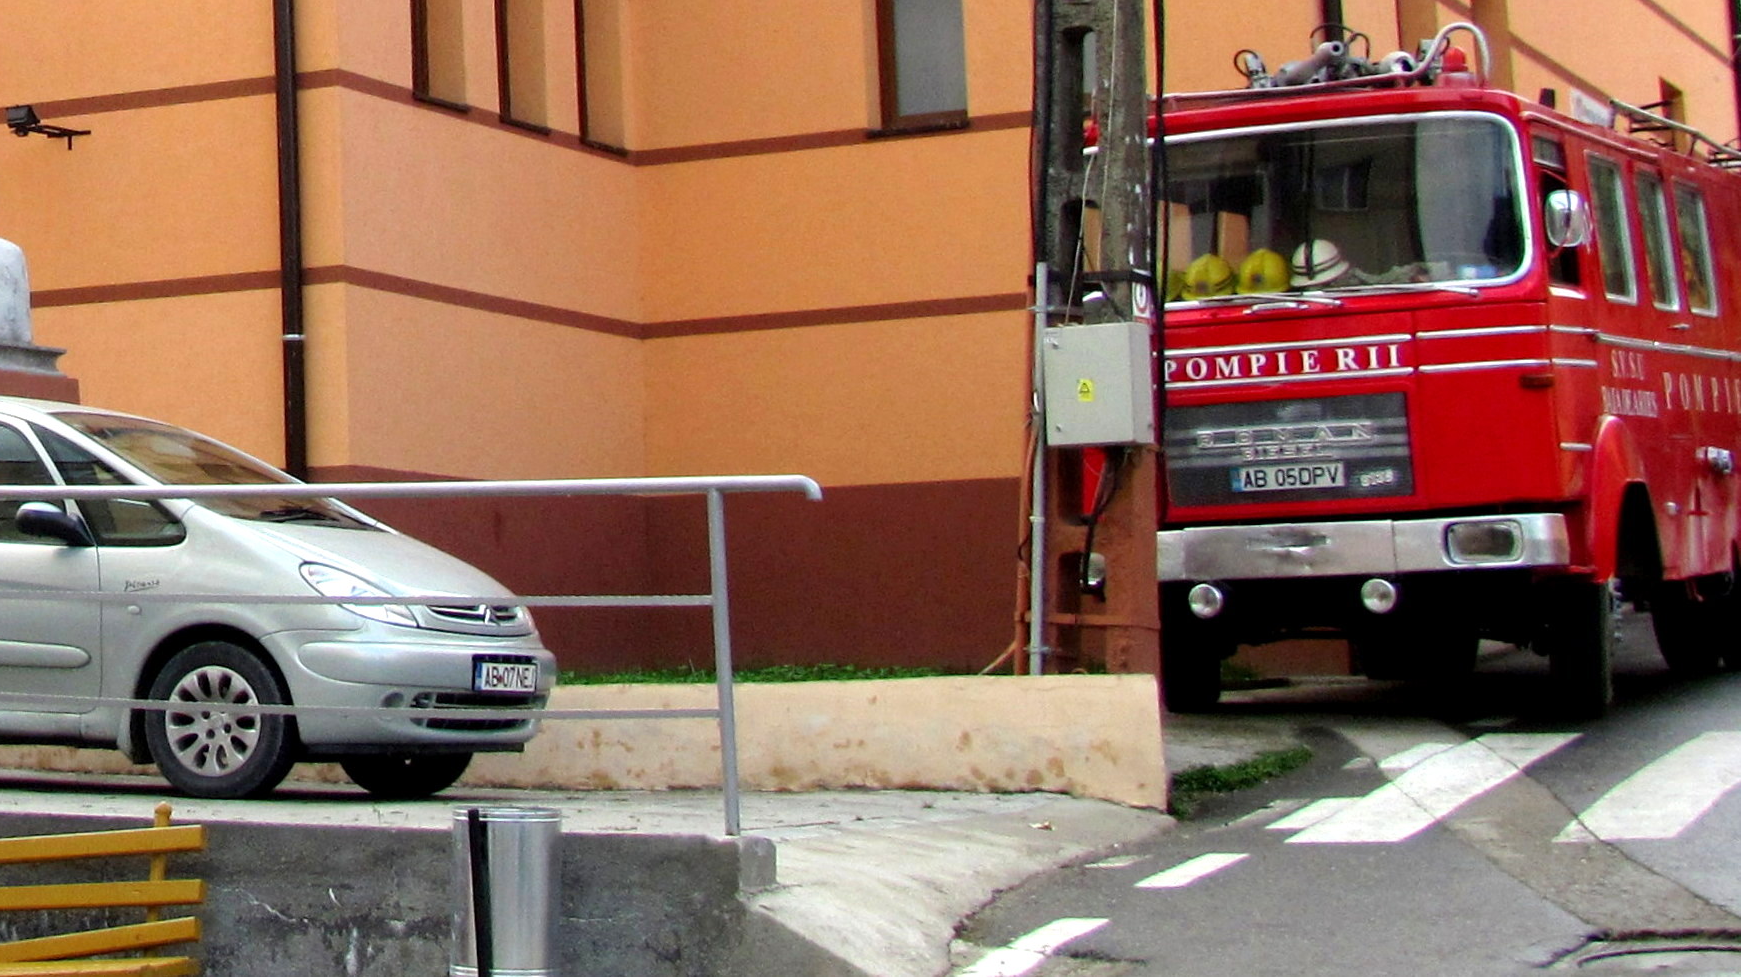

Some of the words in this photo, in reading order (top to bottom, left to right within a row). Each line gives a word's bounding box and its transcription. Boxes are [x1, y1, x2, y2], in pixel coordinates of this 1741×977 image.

[1164, 344, 1400, 382] POMPIERII
[1196, 422, 1372, 449] ROMAN
[1243, 469, 1268, 488] AB
